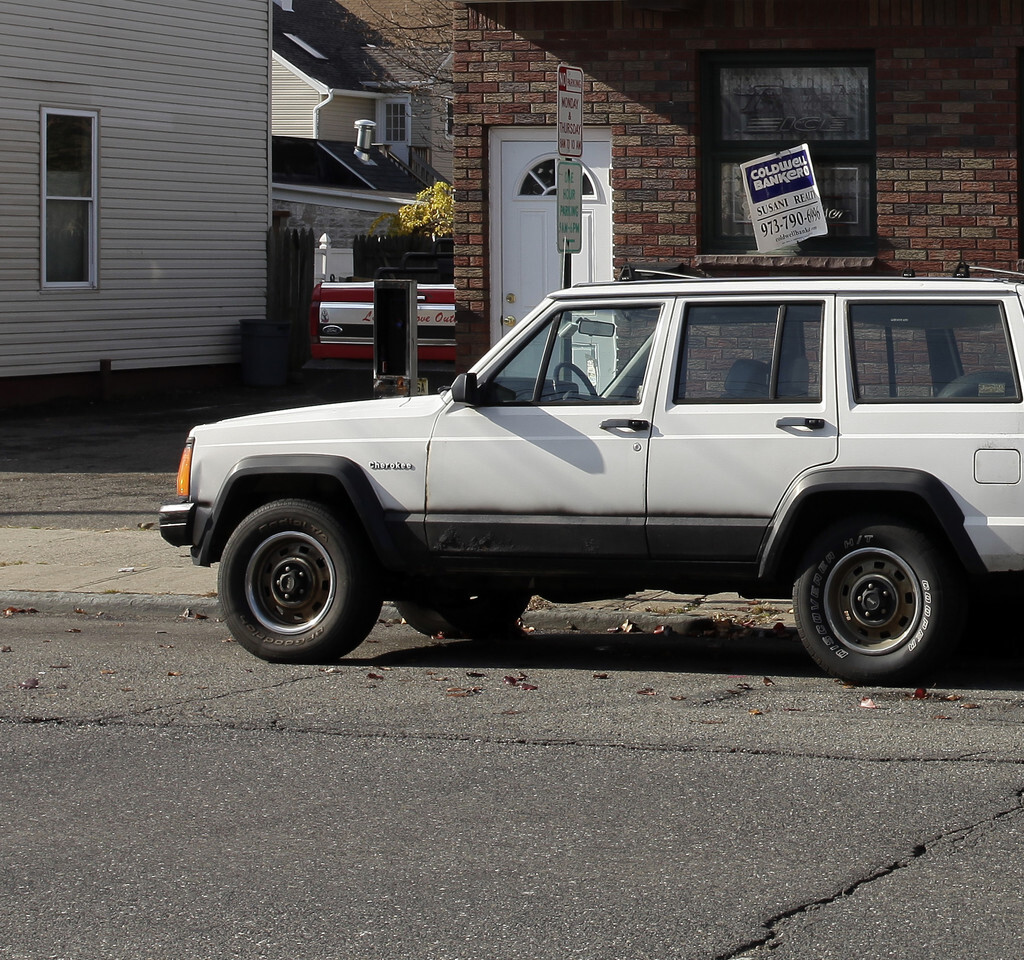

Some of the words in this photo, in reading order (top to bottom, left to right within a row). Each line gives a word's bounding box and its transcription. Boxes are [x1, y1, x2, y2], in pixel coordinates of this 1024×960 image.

[559, 72, 567, 86] NO
[567, 78, 582, 89] PARKING
[561, 97, 579, 110] MONDAY
[559, 120, 582, 135] THURSDAY
[750, 155, 808, 180] COLDWELL
[563, 170, 575, 184] ONE
[753, 168, 805, 191] BANKER
[562, 187, 576, 200] HOUR
[559, 205, 579, 218] PARKING
[756, 198, 789, 217] SUSANI
[368, 460, 412, 471] Cherokee
[843, 534, 874, 550] H/T
[907, 578, 933, 652] COOPER
